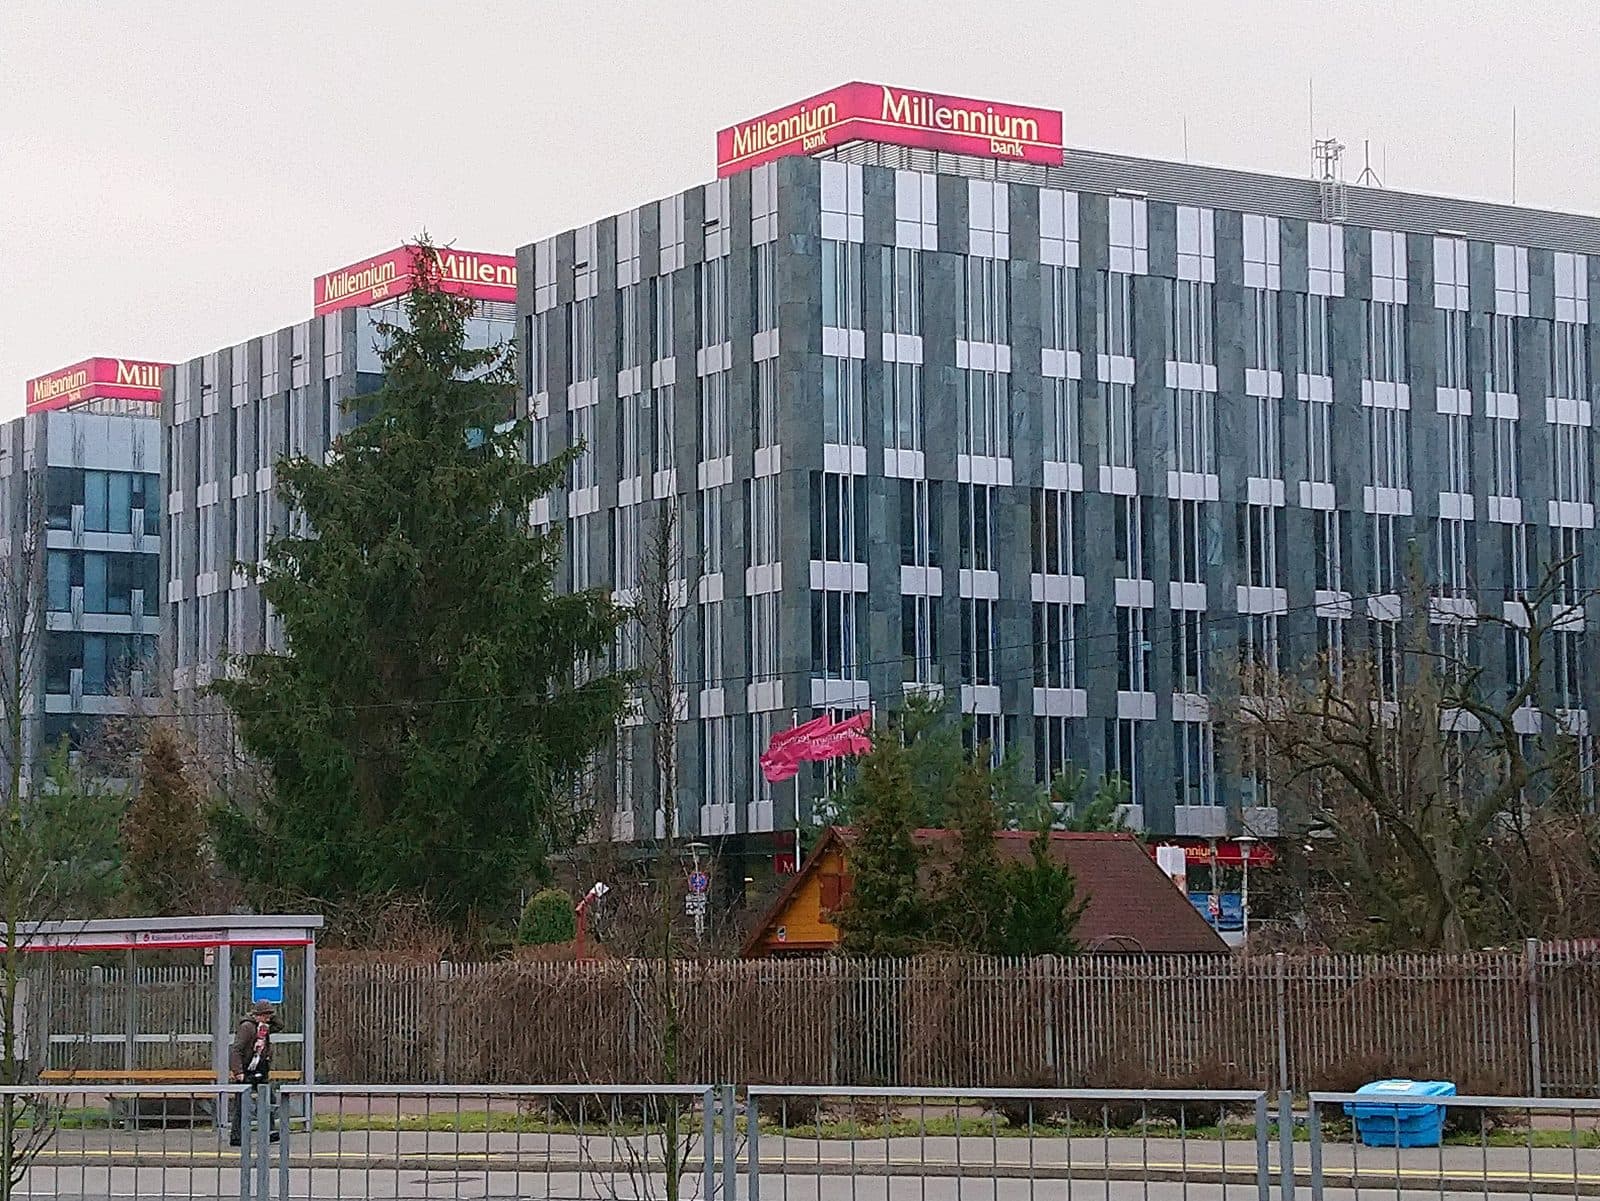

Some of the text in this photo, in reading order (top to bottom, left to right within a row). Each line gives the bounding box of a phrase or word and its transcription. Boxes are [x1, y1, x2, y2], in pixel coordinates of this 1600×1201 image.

[732, 101, 837, 159] Millennium
[881, 85, 1039, 141] Millennium
[803, 130, 827, 152] bank
[990, 138, 1024, 158] bank
[323, 261, 396, 302] Millennium
[33, 370, 87, 402] Millennium
